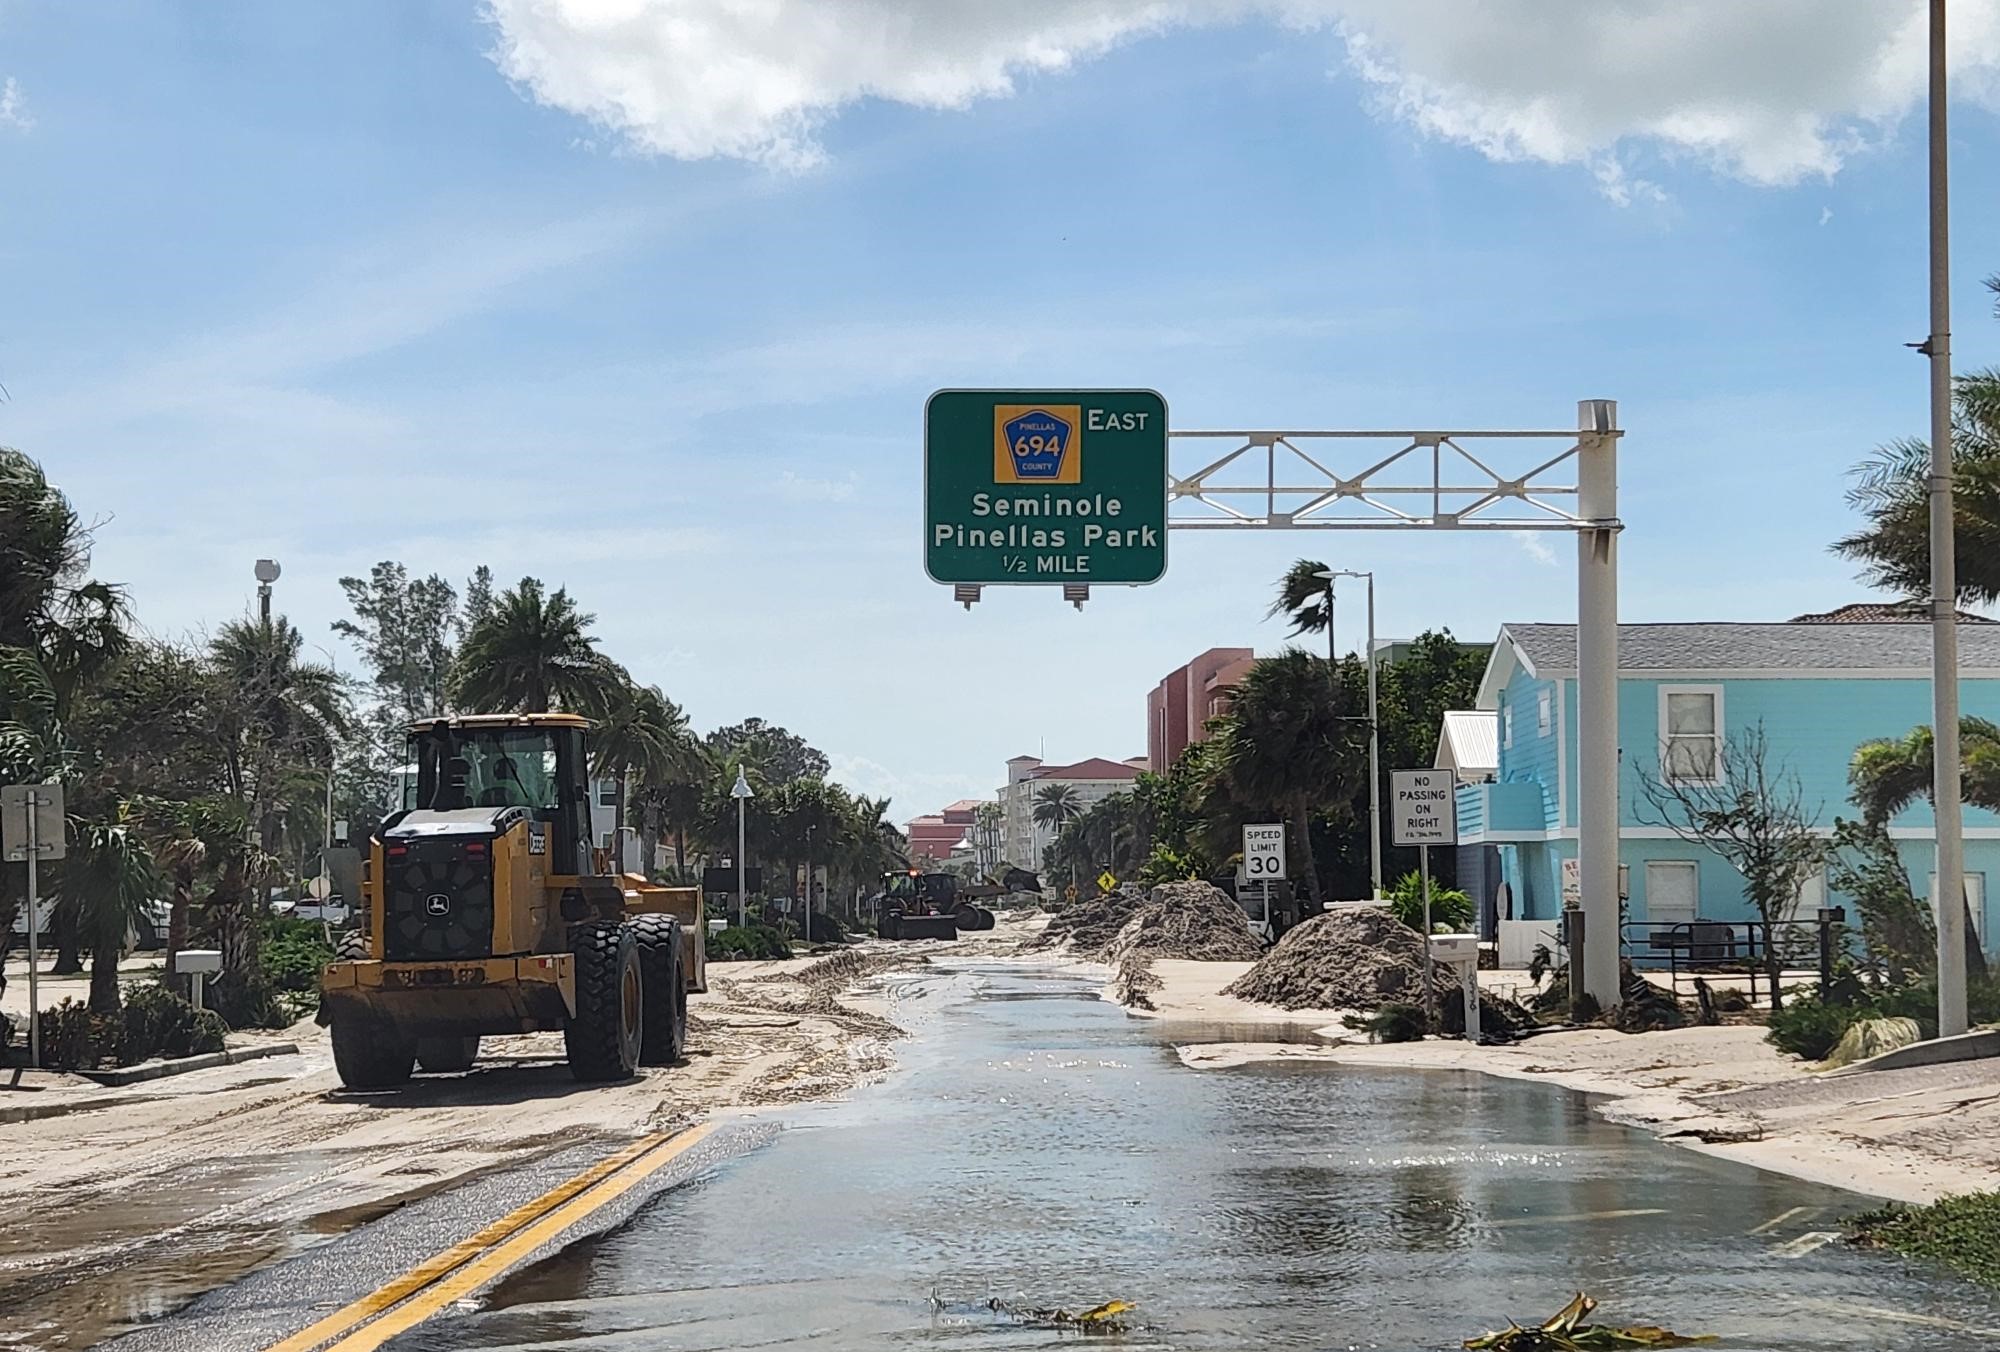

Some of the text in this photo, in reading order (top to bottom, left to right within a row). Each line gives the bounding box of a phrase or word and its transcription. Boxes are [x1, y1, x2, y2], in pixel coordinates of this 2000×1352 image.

[1088, 409, 1148, 431] EAST
[1019, 423, 1056, 431] PINELLAS
[1014, 435, 1060, 457] 694
[1022, 463, 1053, 471] COUNTY
[971, 493, 1122, 516] Seminole
[935, 524, 1158, 547] Pinellas Park
[1037, 556, 1090, 573] MILE
[1414, 776, 1430, 787] NO
[1399, 790, 1447, 801] PASSING
[1415, 804, 1431, 815] ON
[1407, 817, 1440, 828] RIGHT
[1247, 830, 1281, 840] SPEED
[1250, 843, 1278, 852] LIMIT
[1250, 856, 1280, 874] 30
